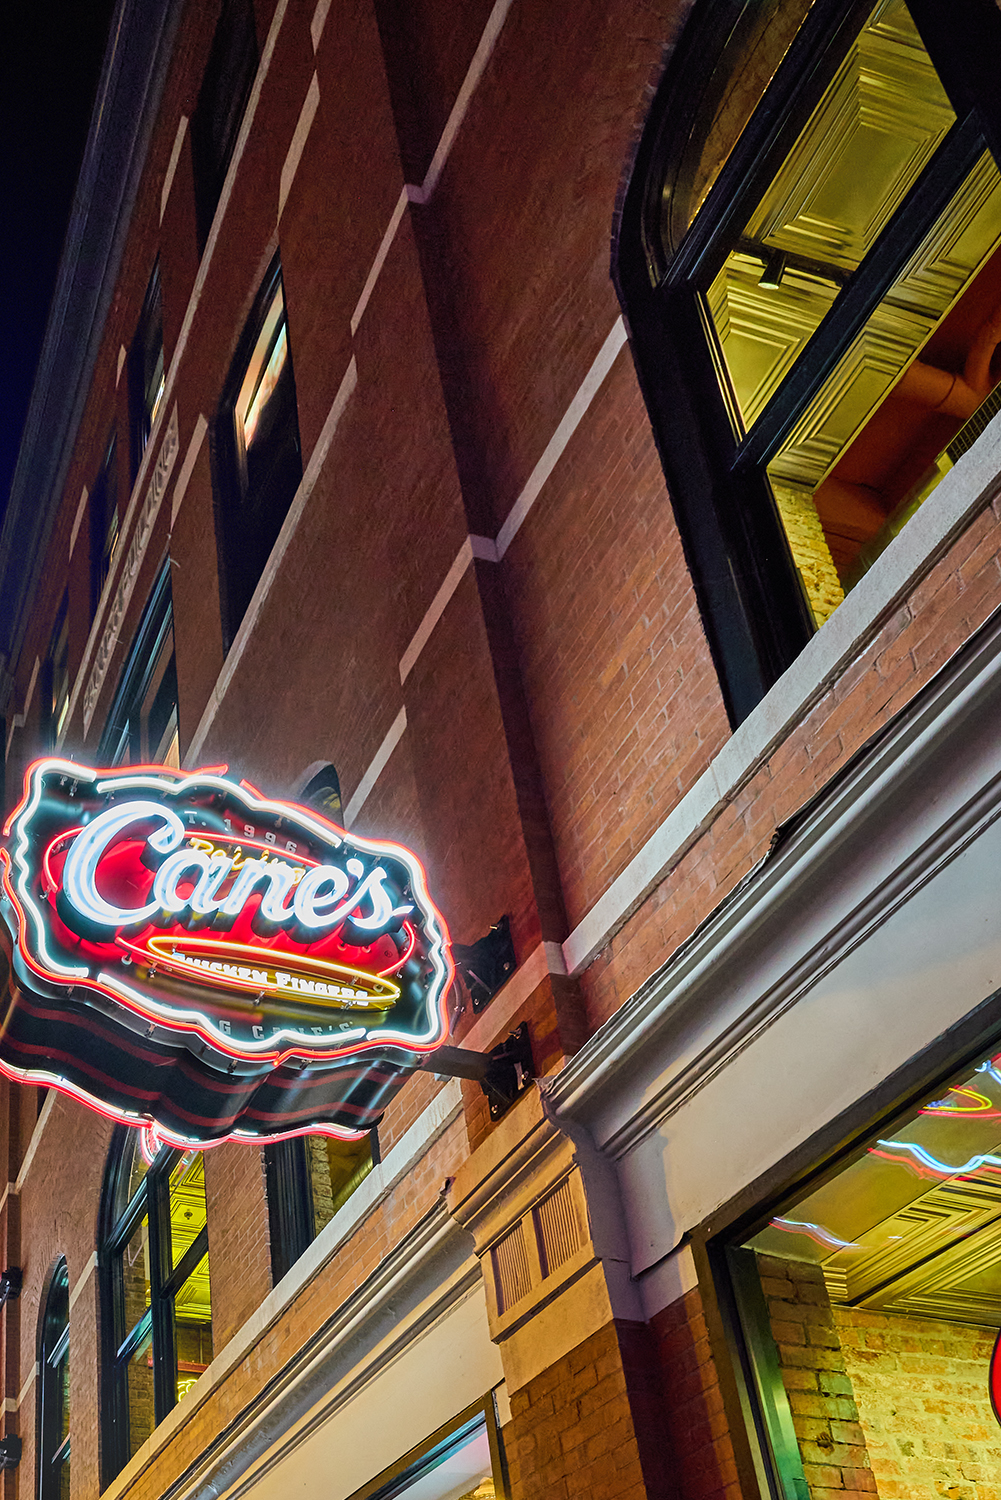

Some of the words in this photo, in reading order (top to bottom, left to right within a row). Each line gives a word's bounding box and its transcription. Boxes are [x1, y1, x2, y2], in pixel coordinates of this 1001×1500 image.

[224, 818, 299, 853] 1996
[63, 800, 415, 930] Cane's
[189, 837, 307, 886] Riig
